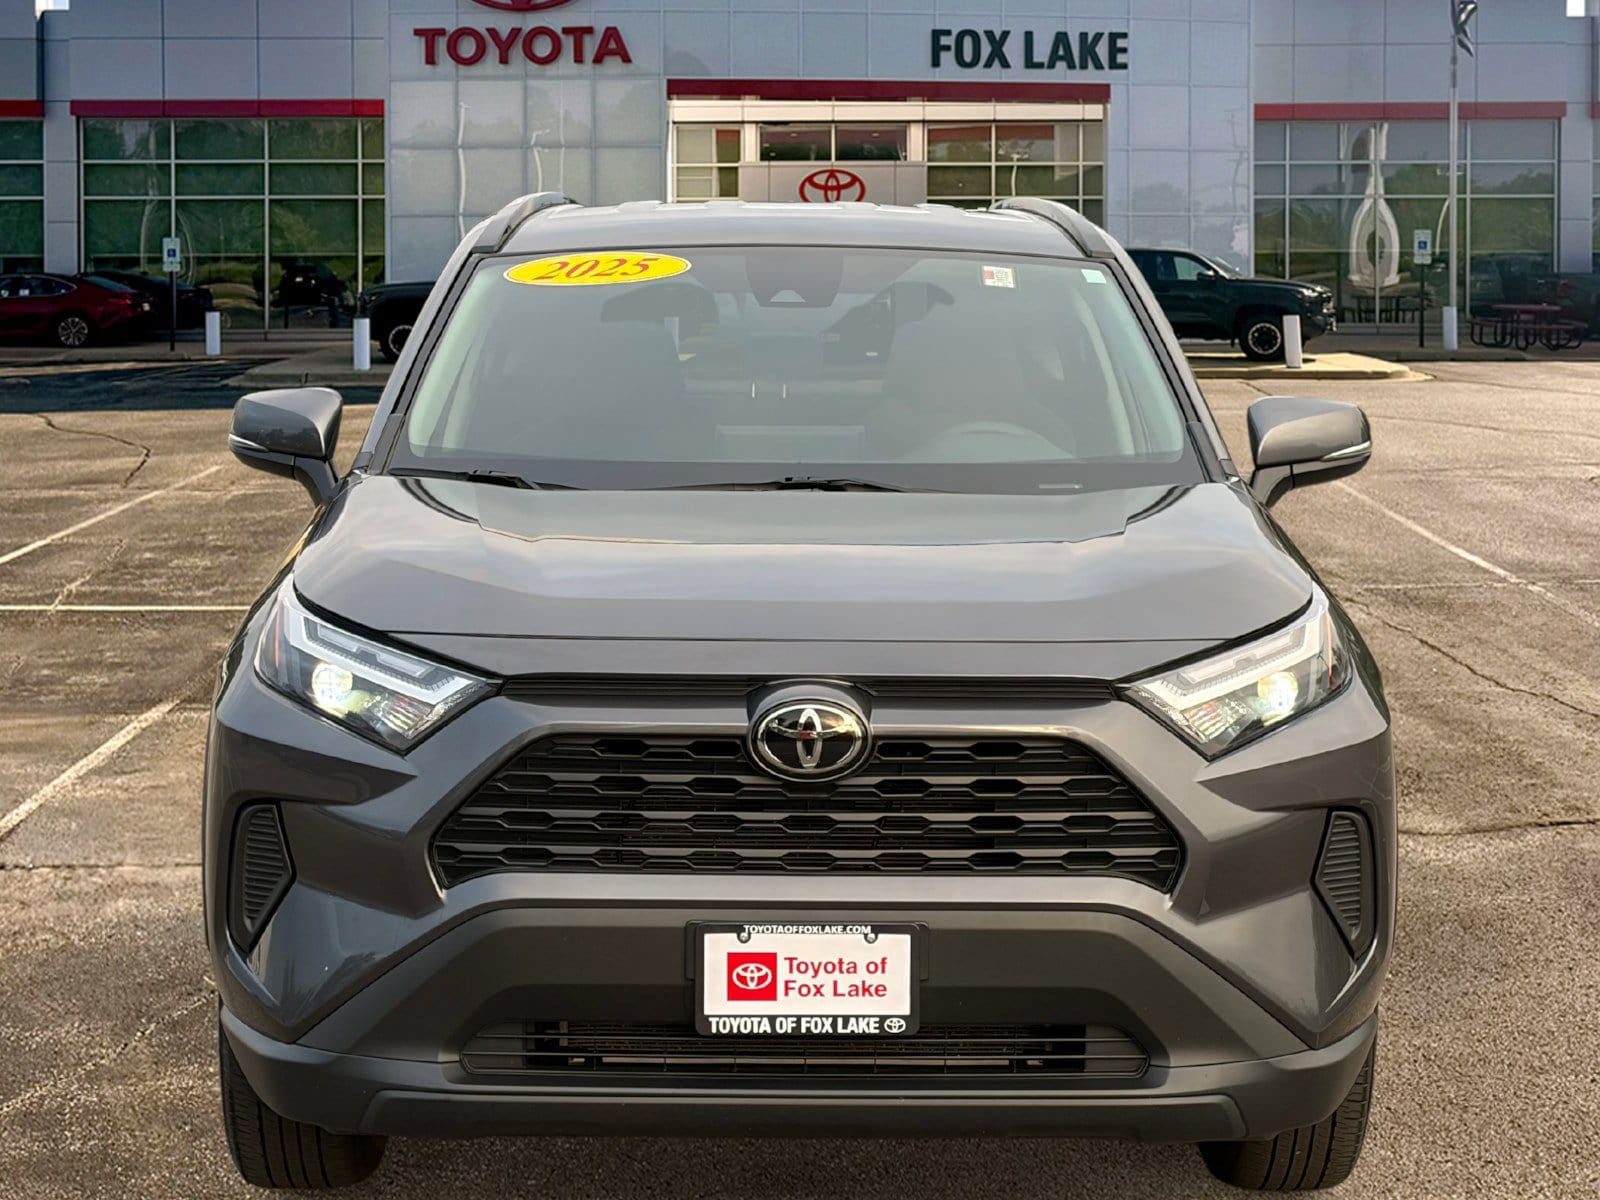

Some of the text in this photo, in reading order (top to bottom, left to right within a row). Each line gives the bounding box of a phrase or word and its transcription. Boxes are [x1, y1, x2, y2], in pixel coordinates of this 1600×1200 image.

[413, 26, 633, 66] TOYOTA
[931, 29, 1129, 71] FOX LAKE
[531, 257, 661, 281] 2025
[743, 925, 872, 935] TOYOTAOFFOXLAKE.COM
[783, 957, 888, 979] Toyota of
[783, 980, 888, 998] Fox Lake
[708, 1017, 880, 1034] TOYOTA OF FOX LAKE
